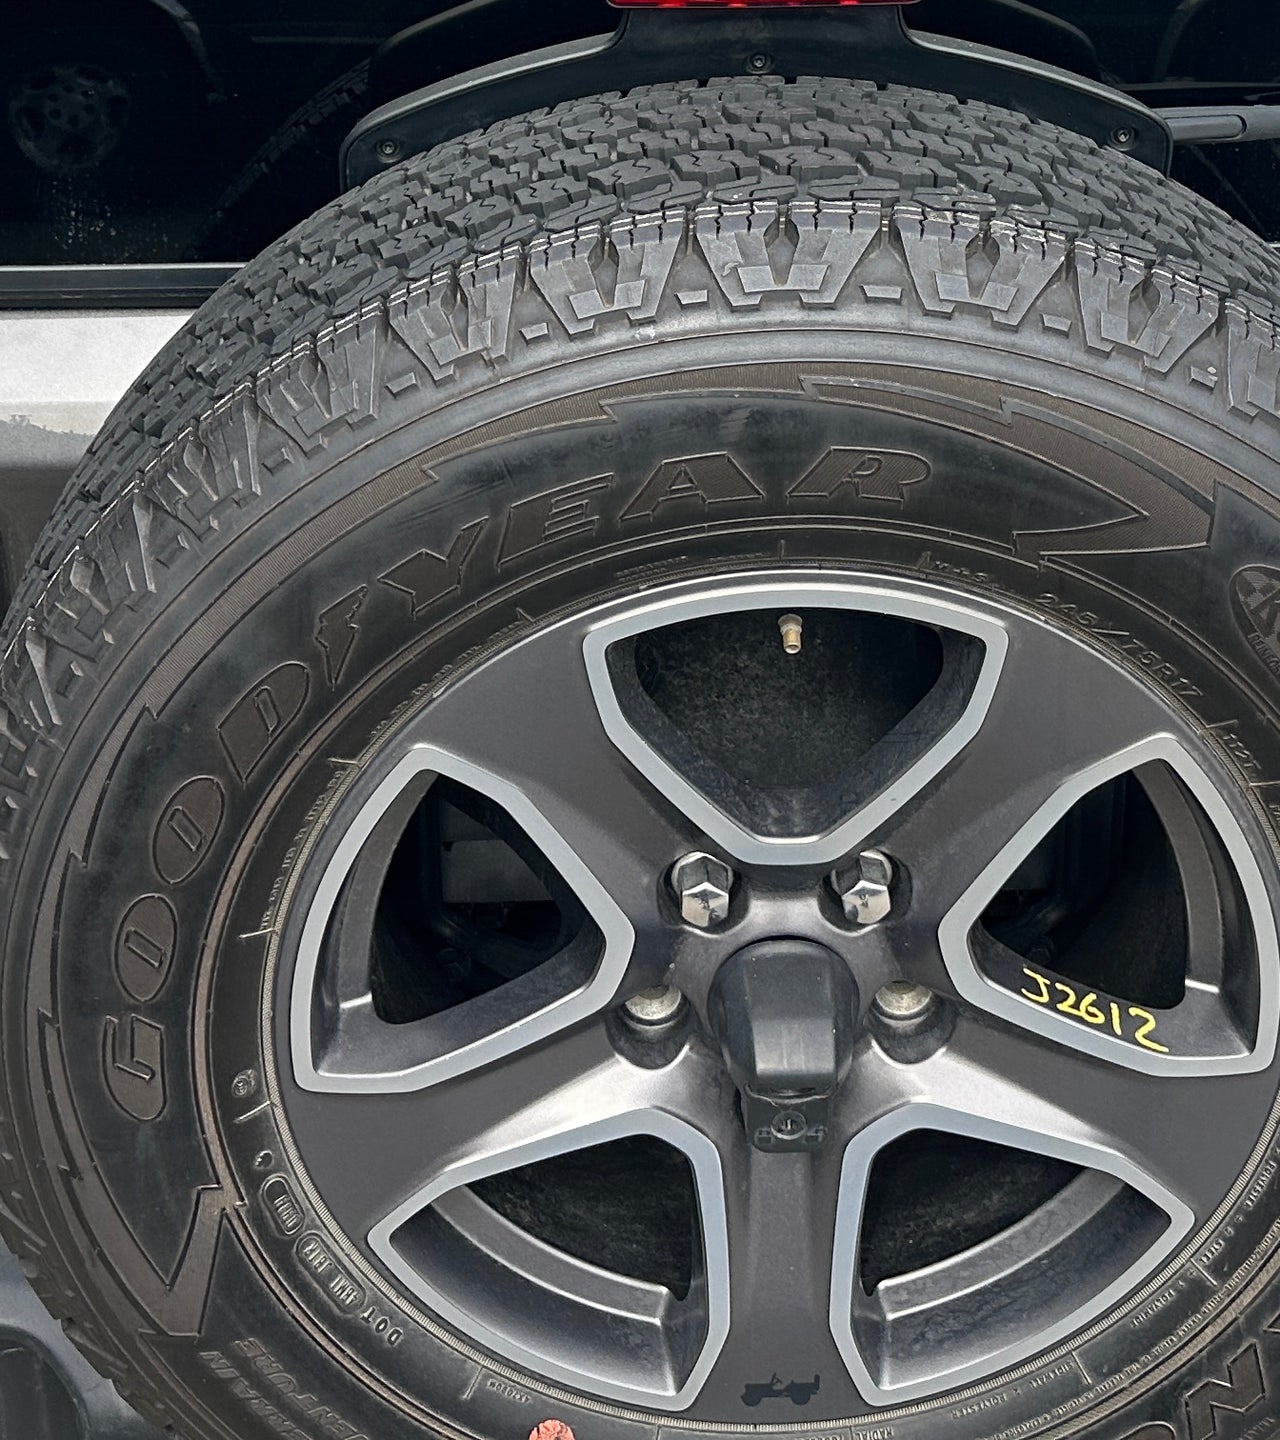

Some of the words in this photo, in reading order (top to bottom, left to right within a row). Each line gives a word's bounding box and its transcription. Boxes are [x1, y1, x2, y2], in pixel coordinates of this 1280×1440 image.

[103, 445, 933, 1121] GOODYEAR
[1020, 966, 1170, 1053] J2612
[361, 1307, 405, 1348] DOT
